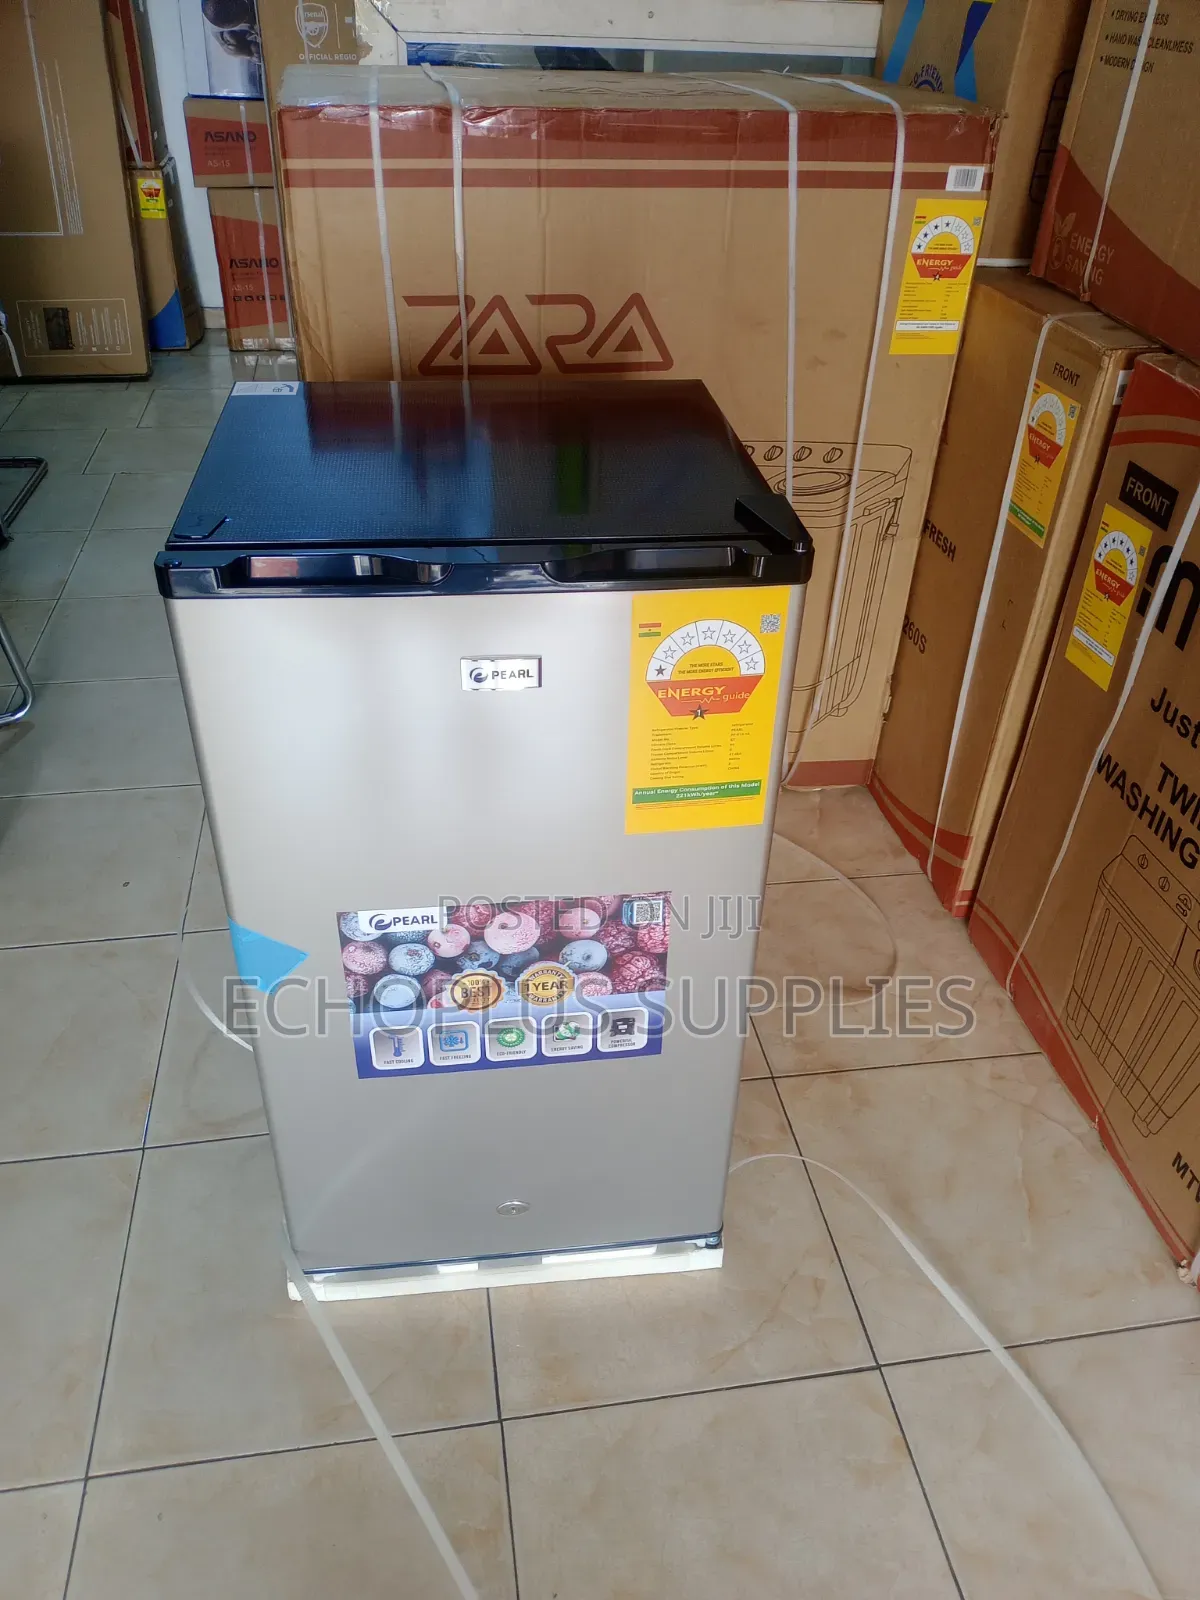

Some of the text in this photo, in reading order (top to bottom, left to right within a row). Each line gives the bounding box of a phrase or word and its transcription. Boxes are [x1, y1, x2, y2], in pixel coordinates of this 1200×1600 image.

[1115, 10, 1138, 23] DRYING
[1109, 32, 1127, 45] HAND
[1104, 54, 1131, 69] MODERN
[916, 257, 954, 267] ENERGY
[402, 292, 674, 377] ZARA
[1052, 361, 1081, 387] FRONT
[1125, 476, 1171, 517] FRONT
[922, 519, 957, 563] FRESH
[1095, 568, 1121, 589] ENERGY
[491, 668, 535, 680] PEARL
[657, 686, 727, 700] ENERGY
[722, 691, 751, 702] guide
[679, 785, 720, 793] Consumption
[1096, 752, 1200, 871] WASHING
[392, 914, 438, 927] PEARL
[461, 986, 491, 998] BEST
[533, 981, 569, 991] YEAR
